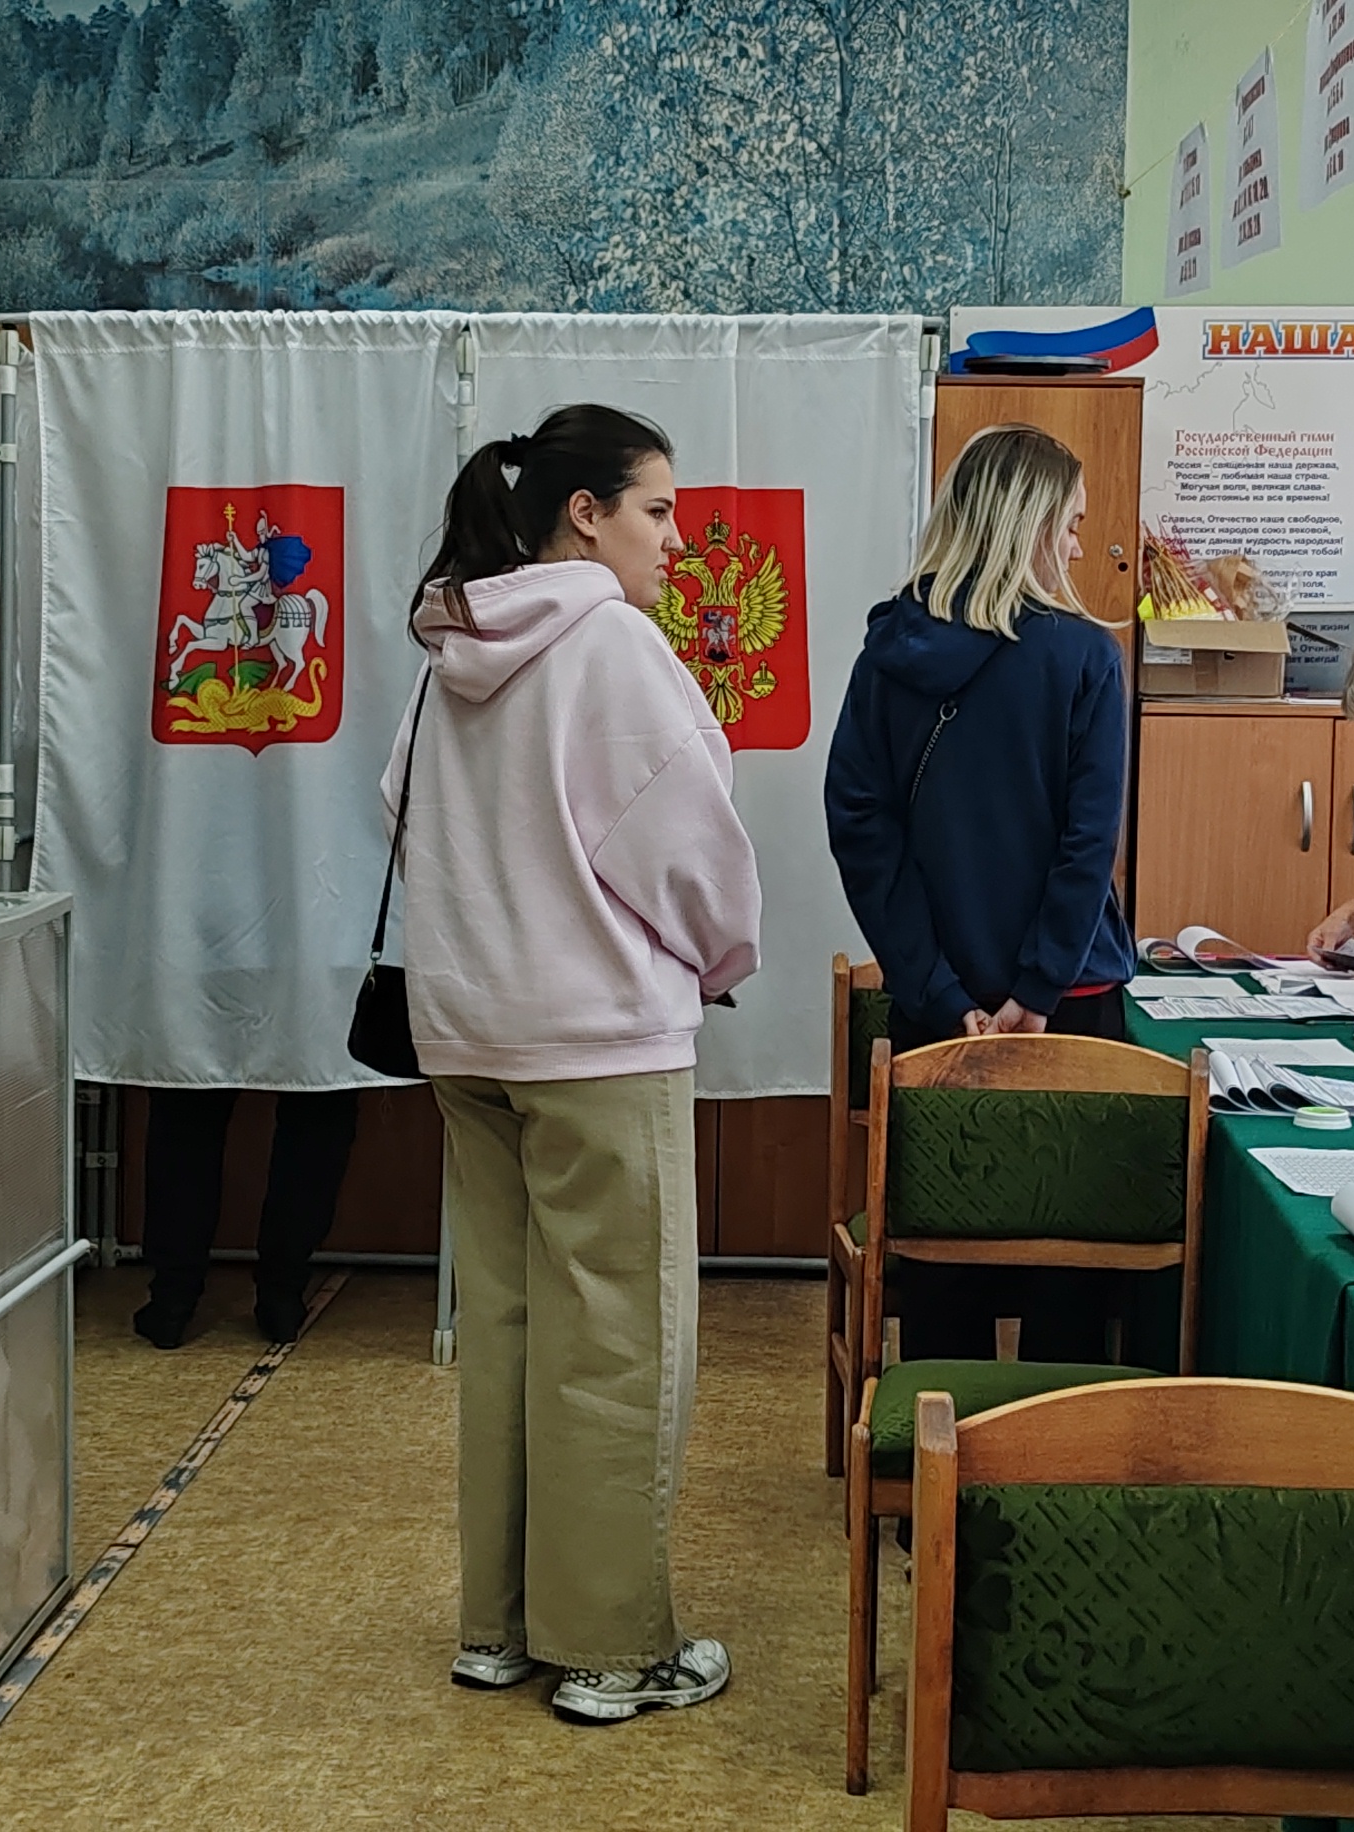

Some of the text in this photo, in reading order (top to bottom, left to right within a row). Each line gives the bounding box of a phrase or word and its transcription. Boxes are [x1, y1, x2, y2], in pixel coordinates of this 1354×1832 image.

[1175, 430, 1334, 445] Государственный гимн
[1175, 443, 1333, 460] Российской Федерации
[1167, 460, 1201, 469] Россия
[1176, 471, 1210, 480] Россия
[1180, 482, 1220, 492] Могучая
[1207, 514, 1258, 523] Отечество
[1287, 514, 1342, 525] свободное,
[1218, 527, 1259, 535] народов
[1289, 526, 1331, 535] вековой,
[1246, 538, 1292, 546] мудрость
[1294, 537, 1344, 546] народная!
[1263, 548, 1308, 556] гордимся
